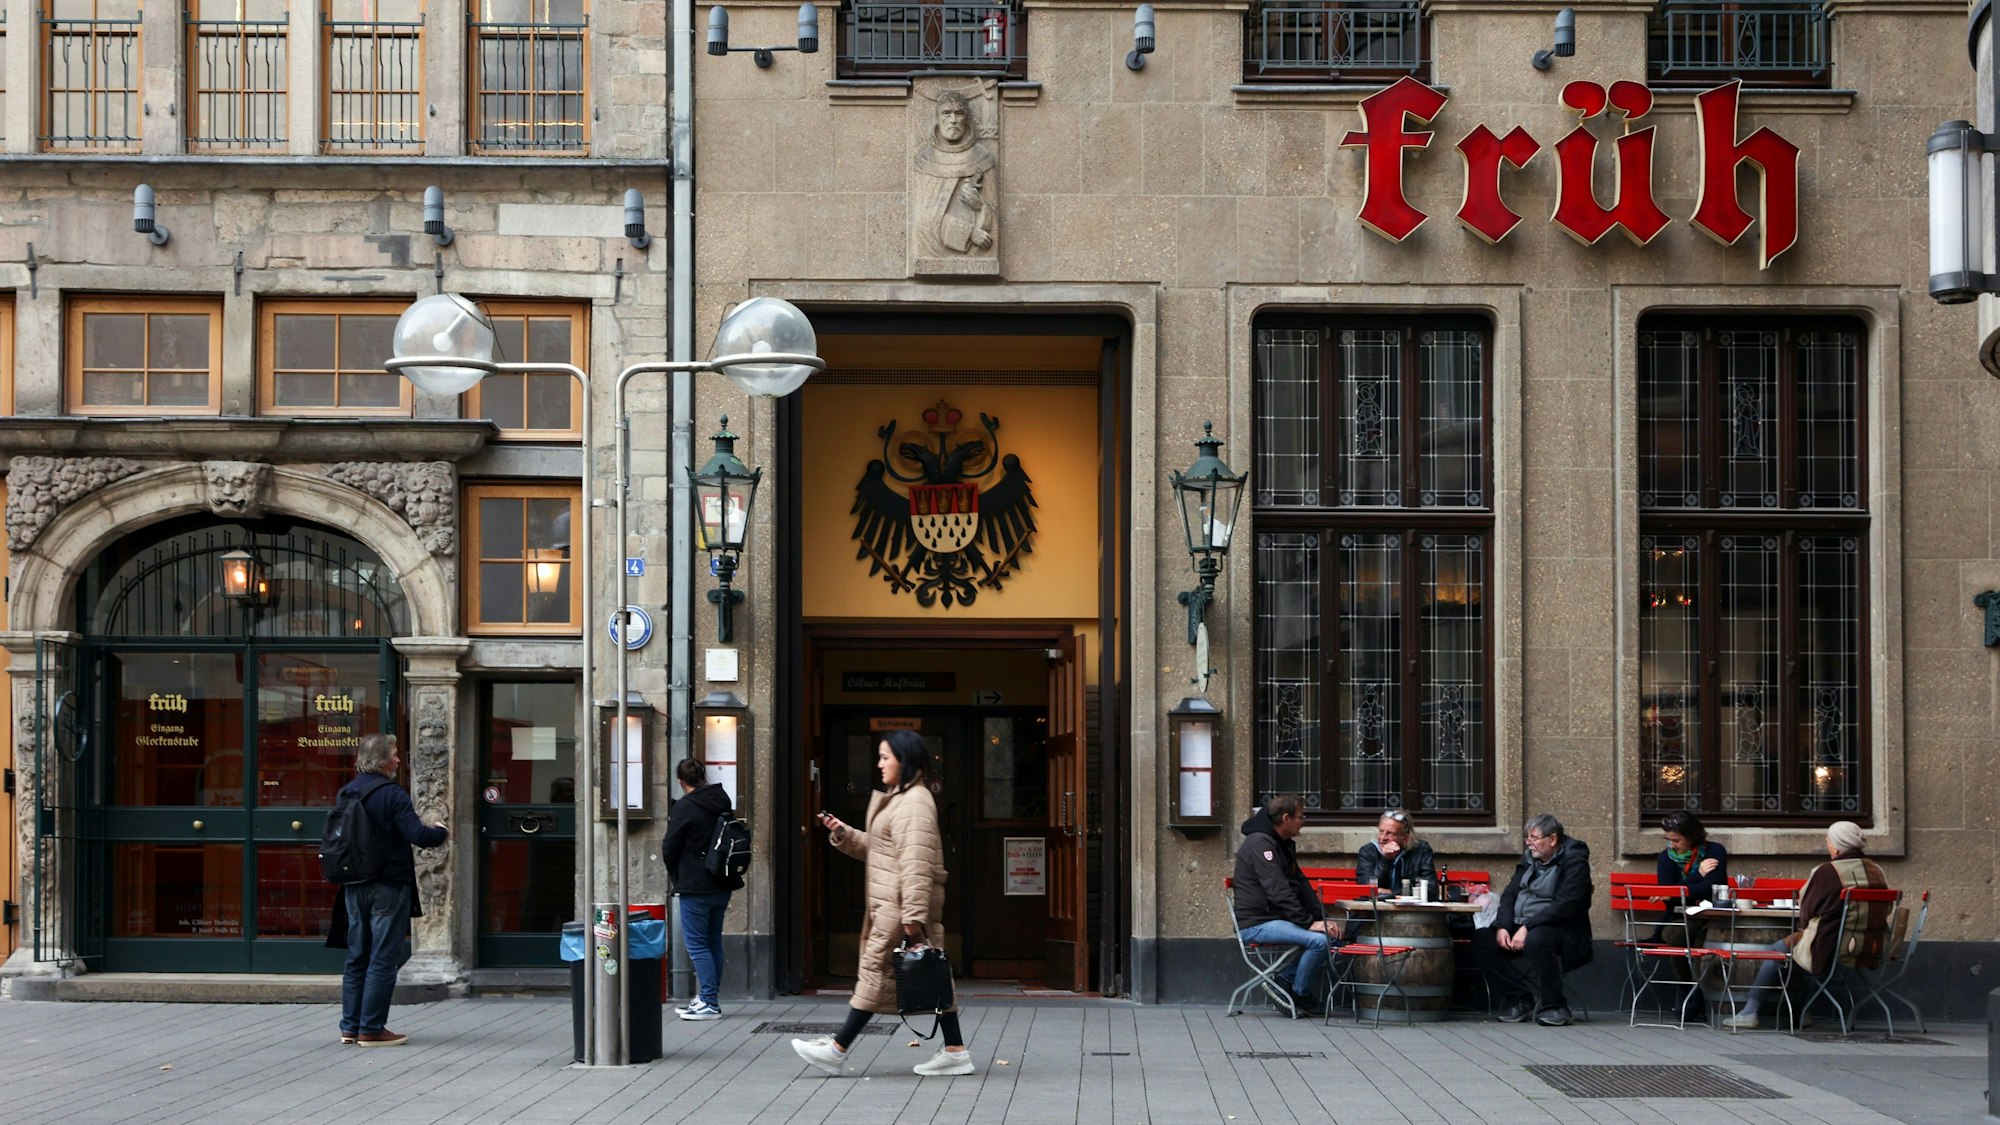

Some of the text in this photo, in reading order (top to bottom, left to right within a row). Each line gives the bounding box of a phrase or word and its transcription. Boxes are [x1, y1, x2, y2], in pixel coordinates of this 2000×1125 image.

[1338, 75, 1800, 271] früh
[148, 693, 188, 714] früh
[313, 693, 354, 714] früh
[150, 724, 184, 734] Eingang
[317, 724, 352, 735] Eingang
[136, 736, 199, 747] Glockenstube
